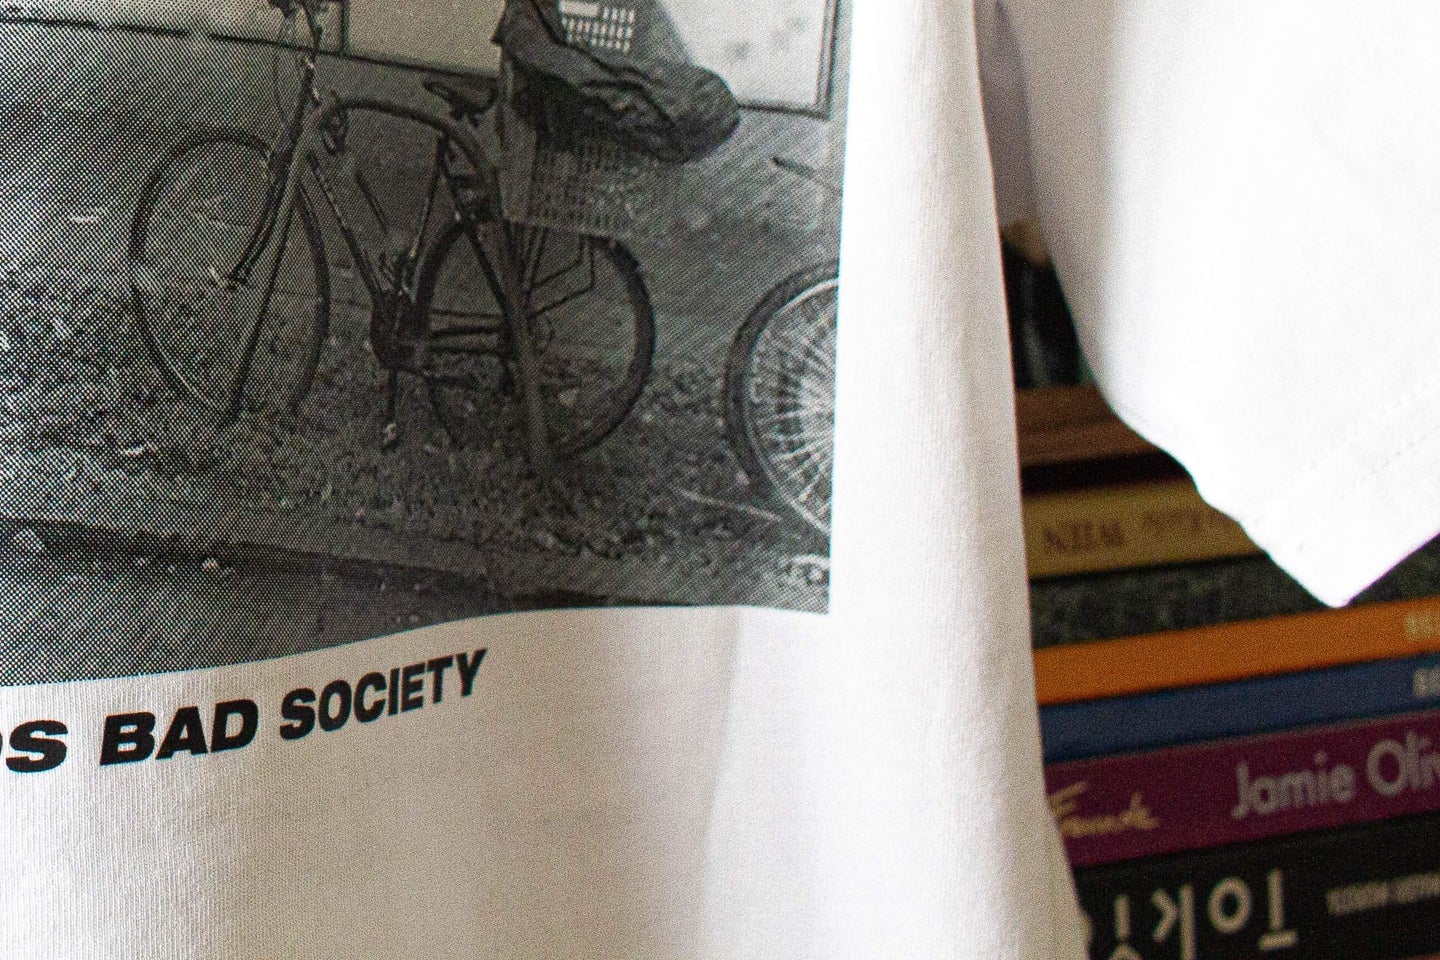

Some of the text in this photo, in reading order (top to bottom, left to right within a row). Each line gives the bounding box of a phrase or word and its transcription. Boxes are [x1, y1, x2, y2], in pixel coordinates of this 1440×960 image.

[99, 698, 259, 767] BAD
[278, 649, 490, 743] SOCIETY
[1230, 750, 1356, 820] Jamie
